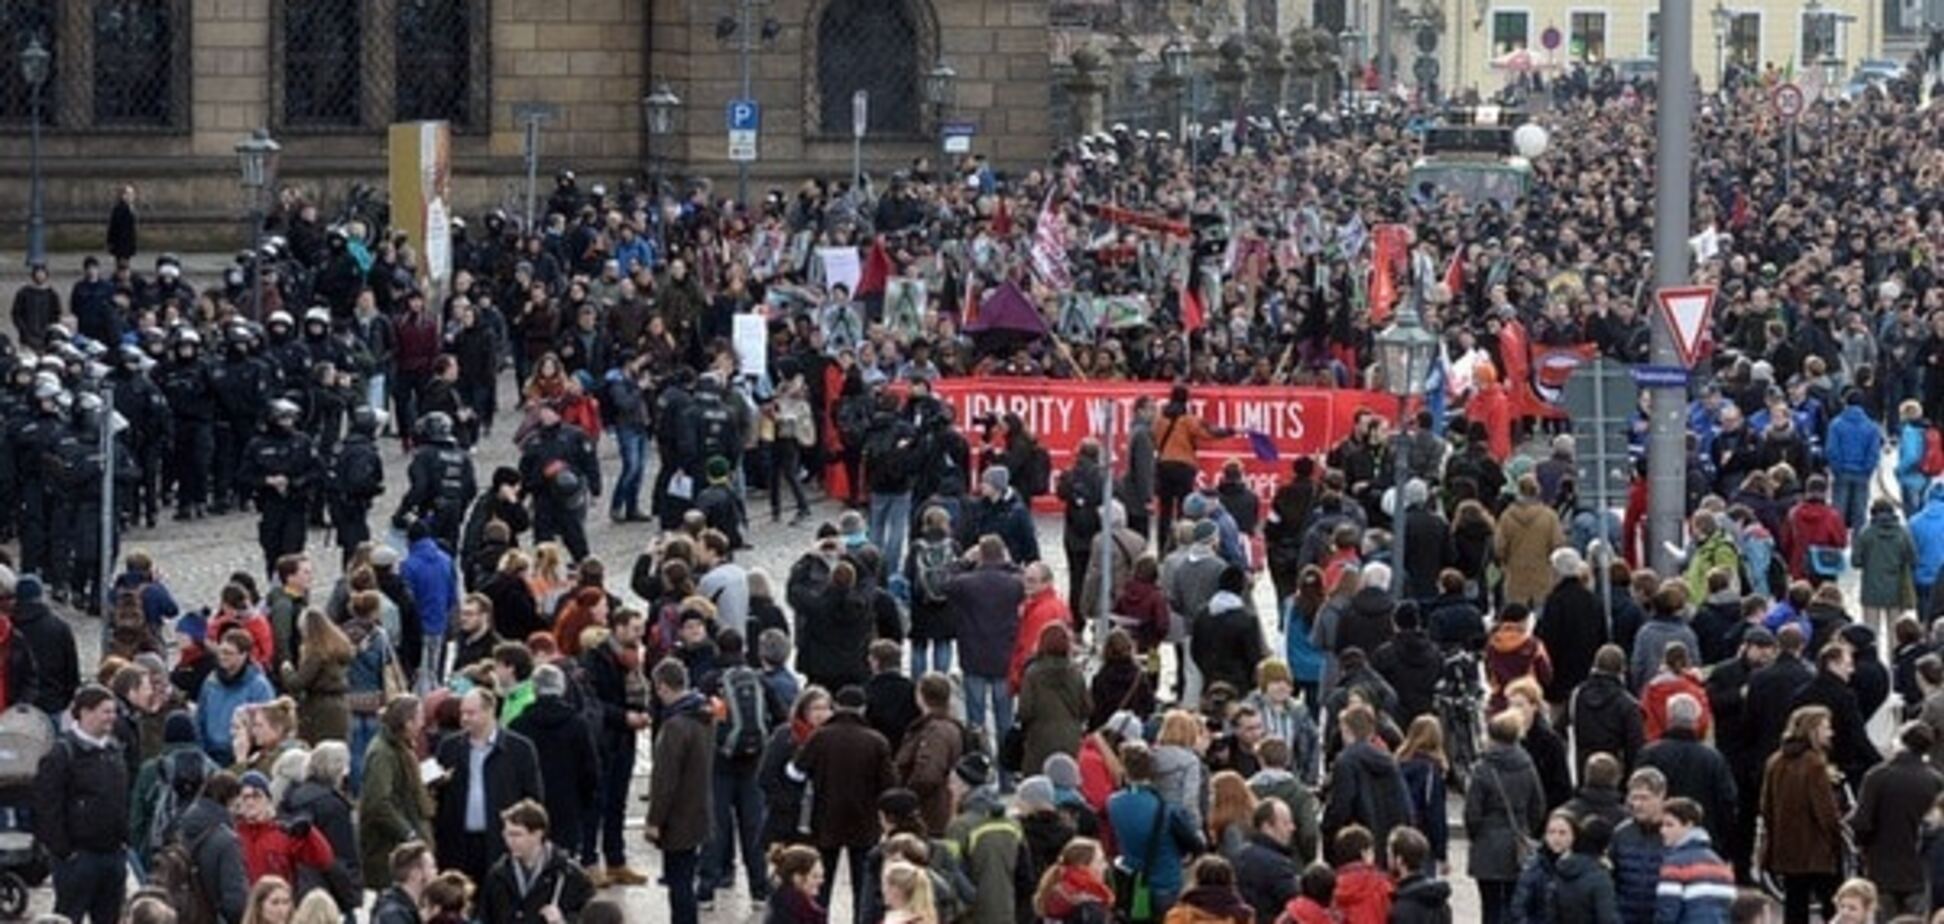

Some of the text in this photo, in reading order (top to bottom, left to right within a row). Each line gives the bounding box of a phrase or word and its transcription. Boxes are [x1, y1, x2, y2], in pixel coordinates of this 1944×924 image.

[735, 104, 751, 127] P
[932, 393, 1304, 439] IDARITY WITT LIMITS
